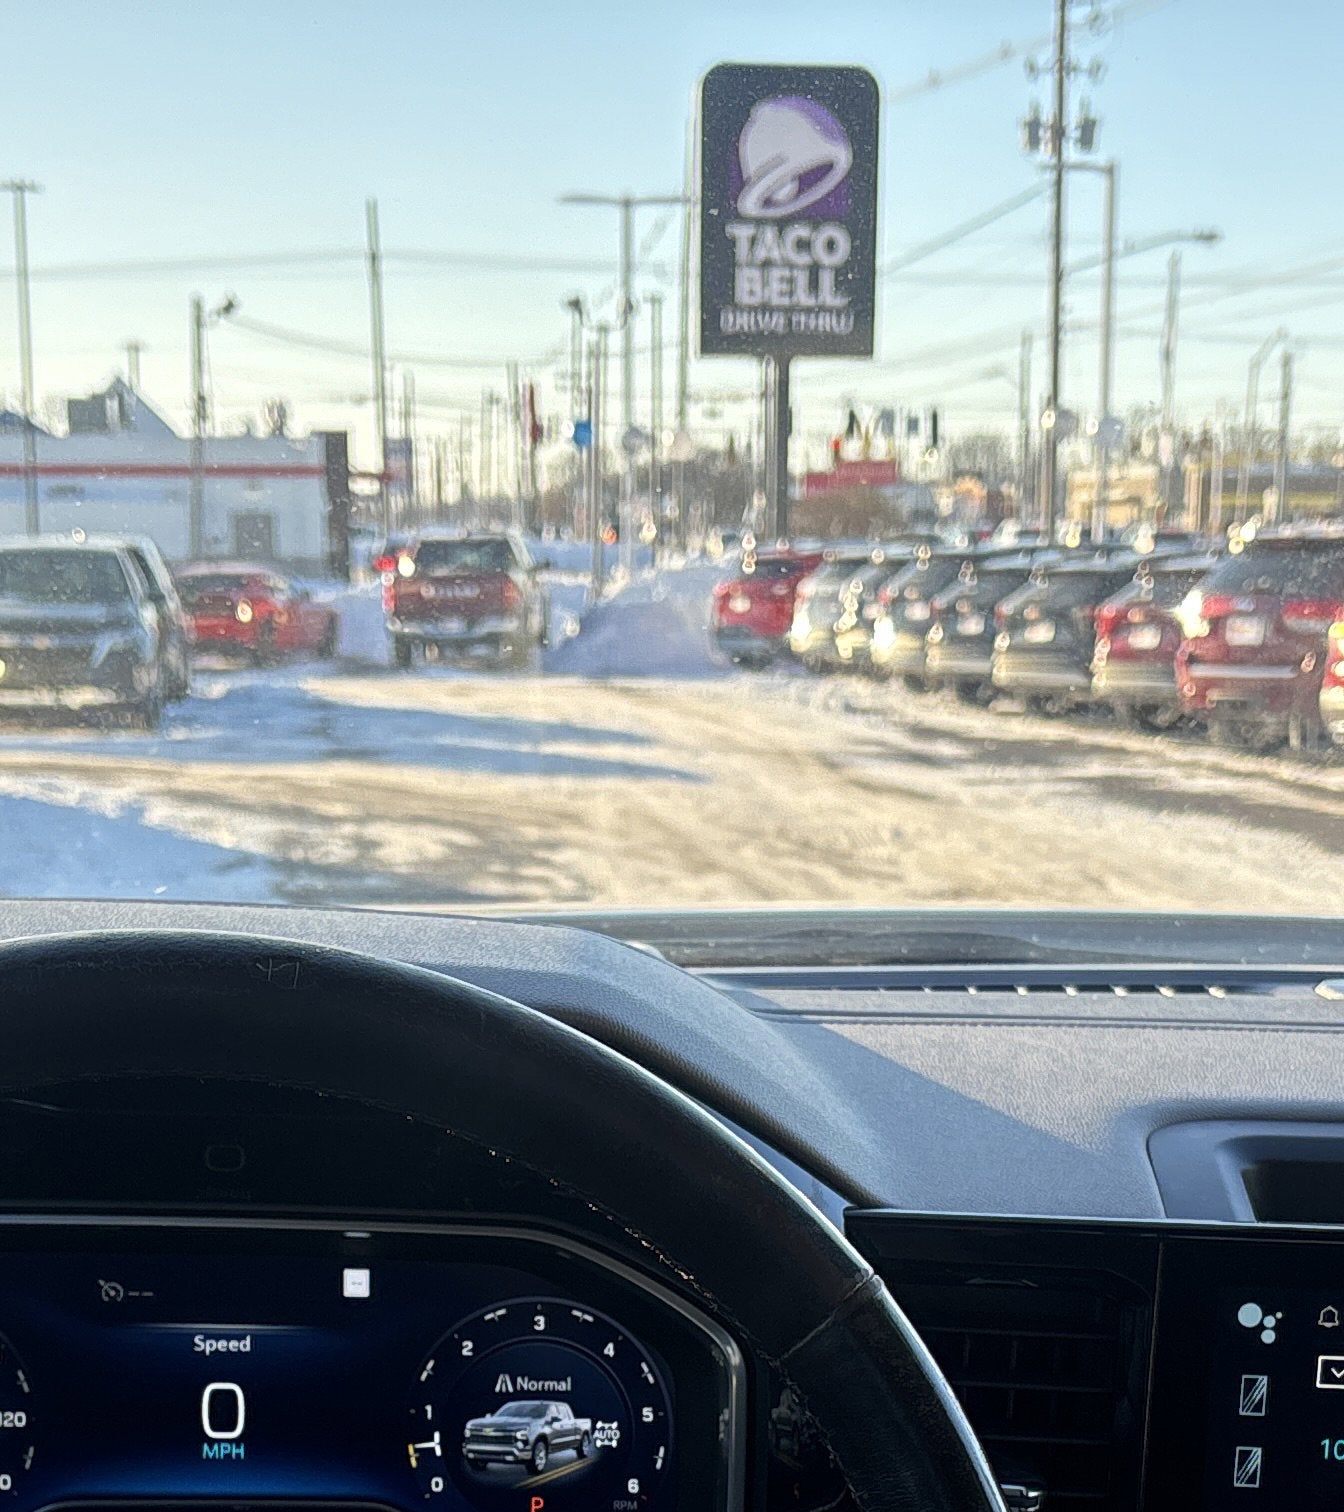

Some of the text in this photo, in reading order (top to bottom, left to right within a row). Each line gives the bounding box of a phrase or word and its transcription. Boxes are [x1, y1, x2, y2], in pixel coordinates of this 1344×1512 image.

[725, 221, 852, 266] TACO
[734, 266, 852, 306] BELL
[533, 1315, 545, 1331] 3
[193, 1334, 251, 1356] Speed
[461, 1340, 474, 1356] 2
[603, 1342, 615, 1358] 4
[516, 1376, 572, 1392] Normal
[201, 1382, 246, 1439] 0
[424, 1404, 432, 1421] 1
[642, 1406, 654, 1423] 5
[593, 1429, 620, 1440] AUTO
[202, 1442, 245, 1459] MPH
[430, 1476, 444, 1493] 0
[627, 1478, 640, 1494] 6
[613, 1500, 638, 1511] RPM
